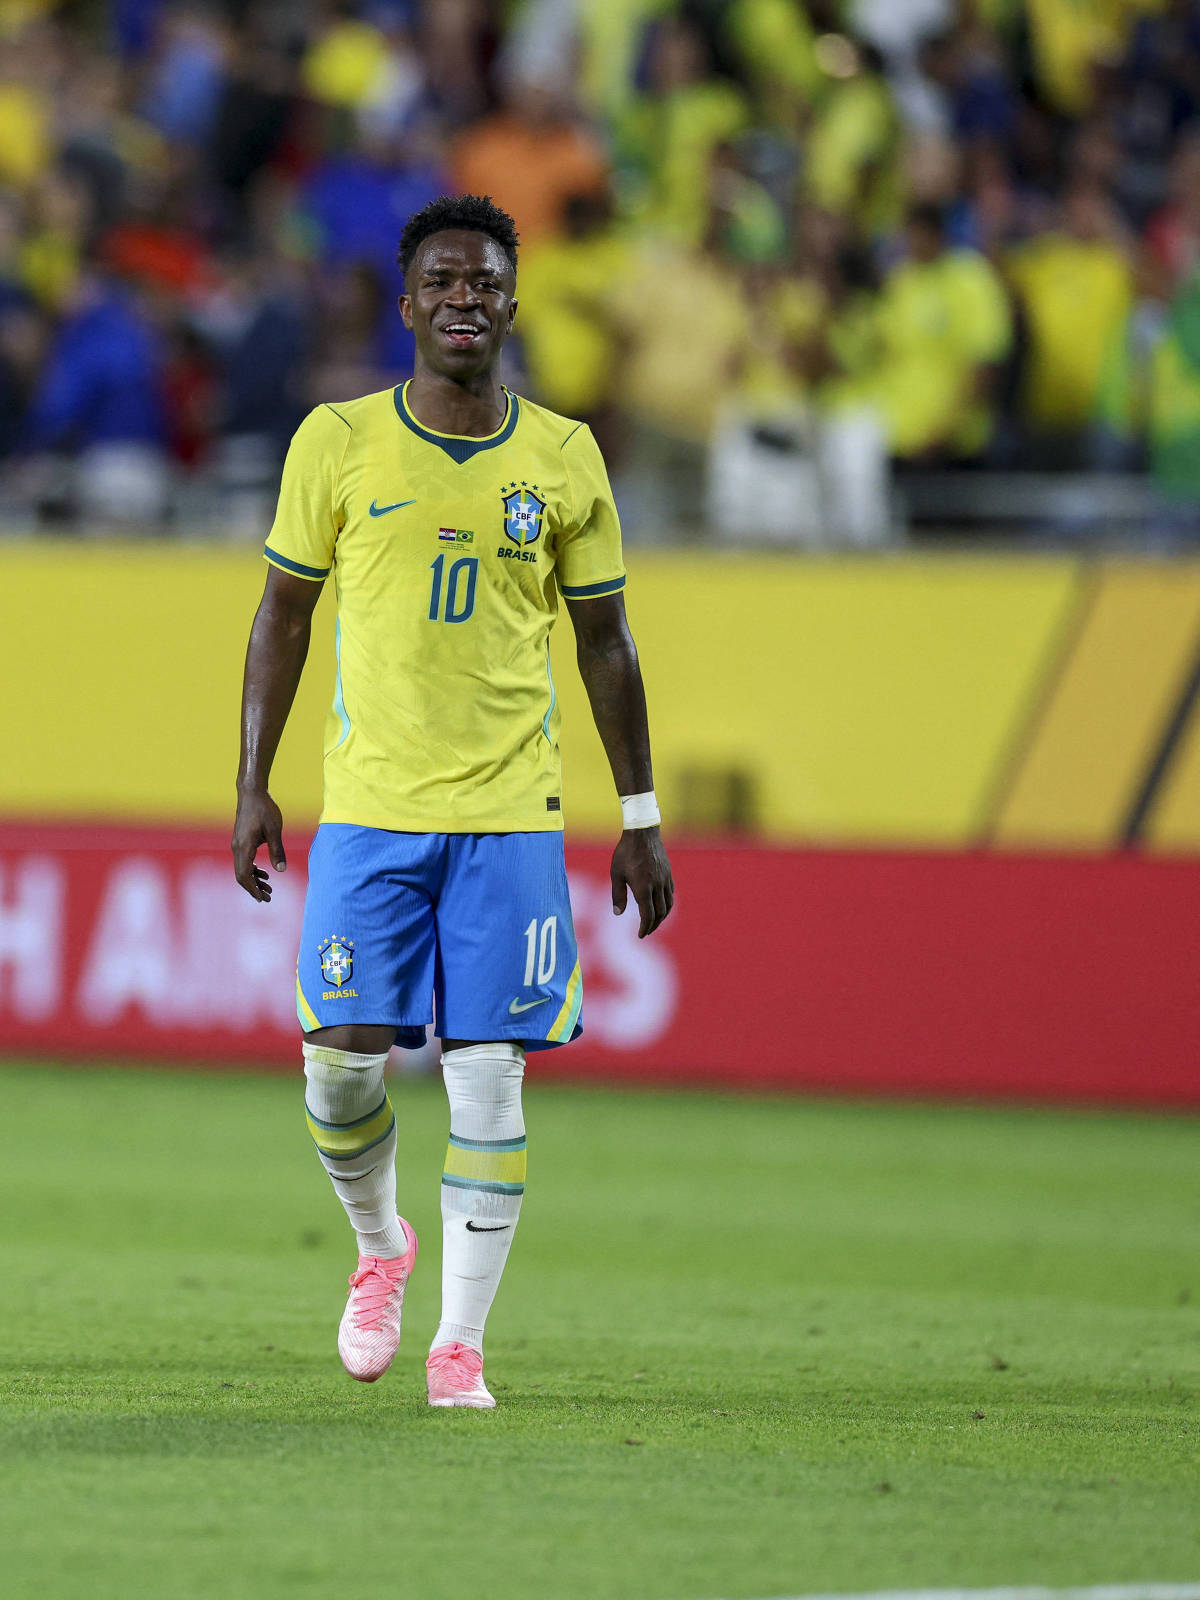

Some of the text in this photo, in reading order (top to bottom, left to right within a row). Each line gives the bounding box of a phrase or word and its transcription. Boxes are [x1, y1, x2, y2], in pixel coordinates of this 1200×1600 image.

[515, 512, 532, 521] CBF
[497, 547, 538, 563] BRASIL
[428, 553, 480, 624] 10
[523, 916, 558, 987] 10
[329, 959, 343, 967] CBF
[322, 988, 359, 1001] BRASIL
